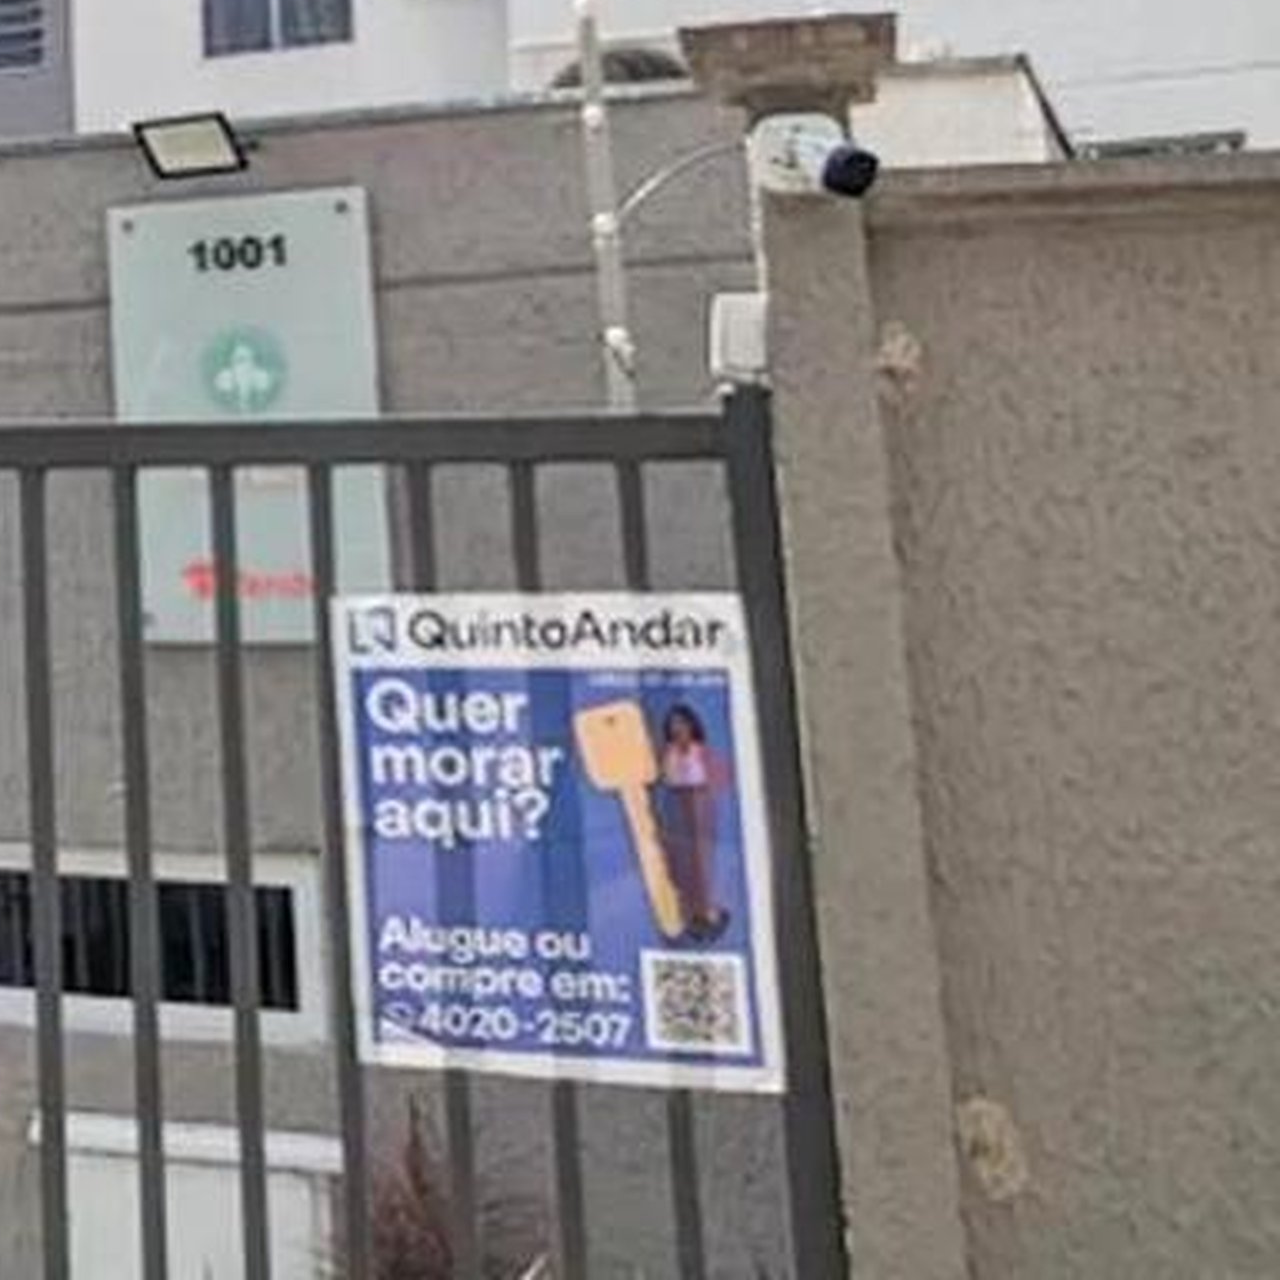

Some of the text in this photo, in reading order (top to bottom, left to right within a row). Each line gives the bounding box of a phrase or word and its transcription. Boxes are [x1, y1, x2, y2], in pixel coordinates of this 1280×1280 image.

[188, 235, 287, 271] 1001
[407, 609, 725, 651] QuintoAndar
[366, 677, 529, 734] Quer
[370, 742, 563, 787] morar
[374, 789, 550, 848] aqui?
[379, 916, 590, 962] Alugue ou
[378, 961, 632, 1003] compre em:
